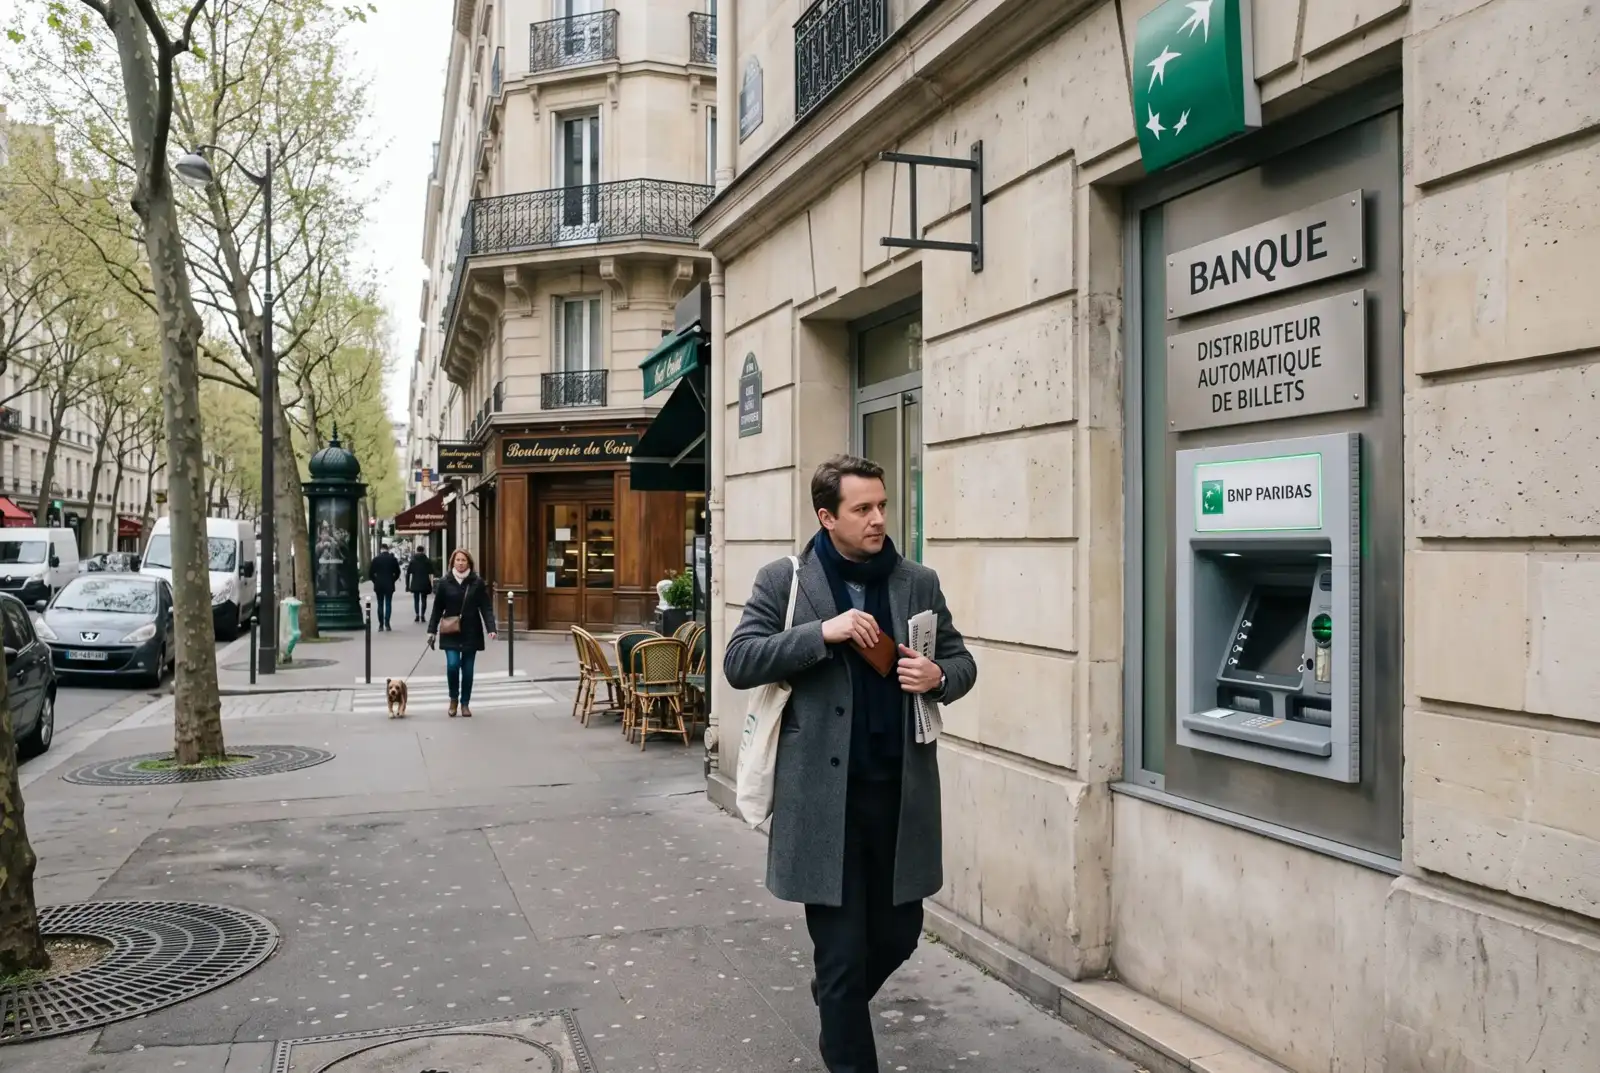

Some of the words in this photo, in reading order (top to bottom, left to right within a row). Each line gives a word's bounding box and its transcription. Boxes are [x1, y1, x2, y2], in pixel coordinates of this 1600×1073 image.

[1190, 221, 1327, 295] BANQUE
[1198, 316, 1320, 361] DISTRIBUTEUR
[1198, 346, 1322, 388] AUTOMATIQUE
[1212, 392, 1232, 413] DE
[1238, 380, 1305, 410] BILLETS
[506, 442, 581, 462] Boulangerie
[583, 443, 600, 455] du
[603, 440, 633, 454] Coin
[1227, 487, 1253, 502] BNP
[1256, 483, 1312, 500] PARIBAS
